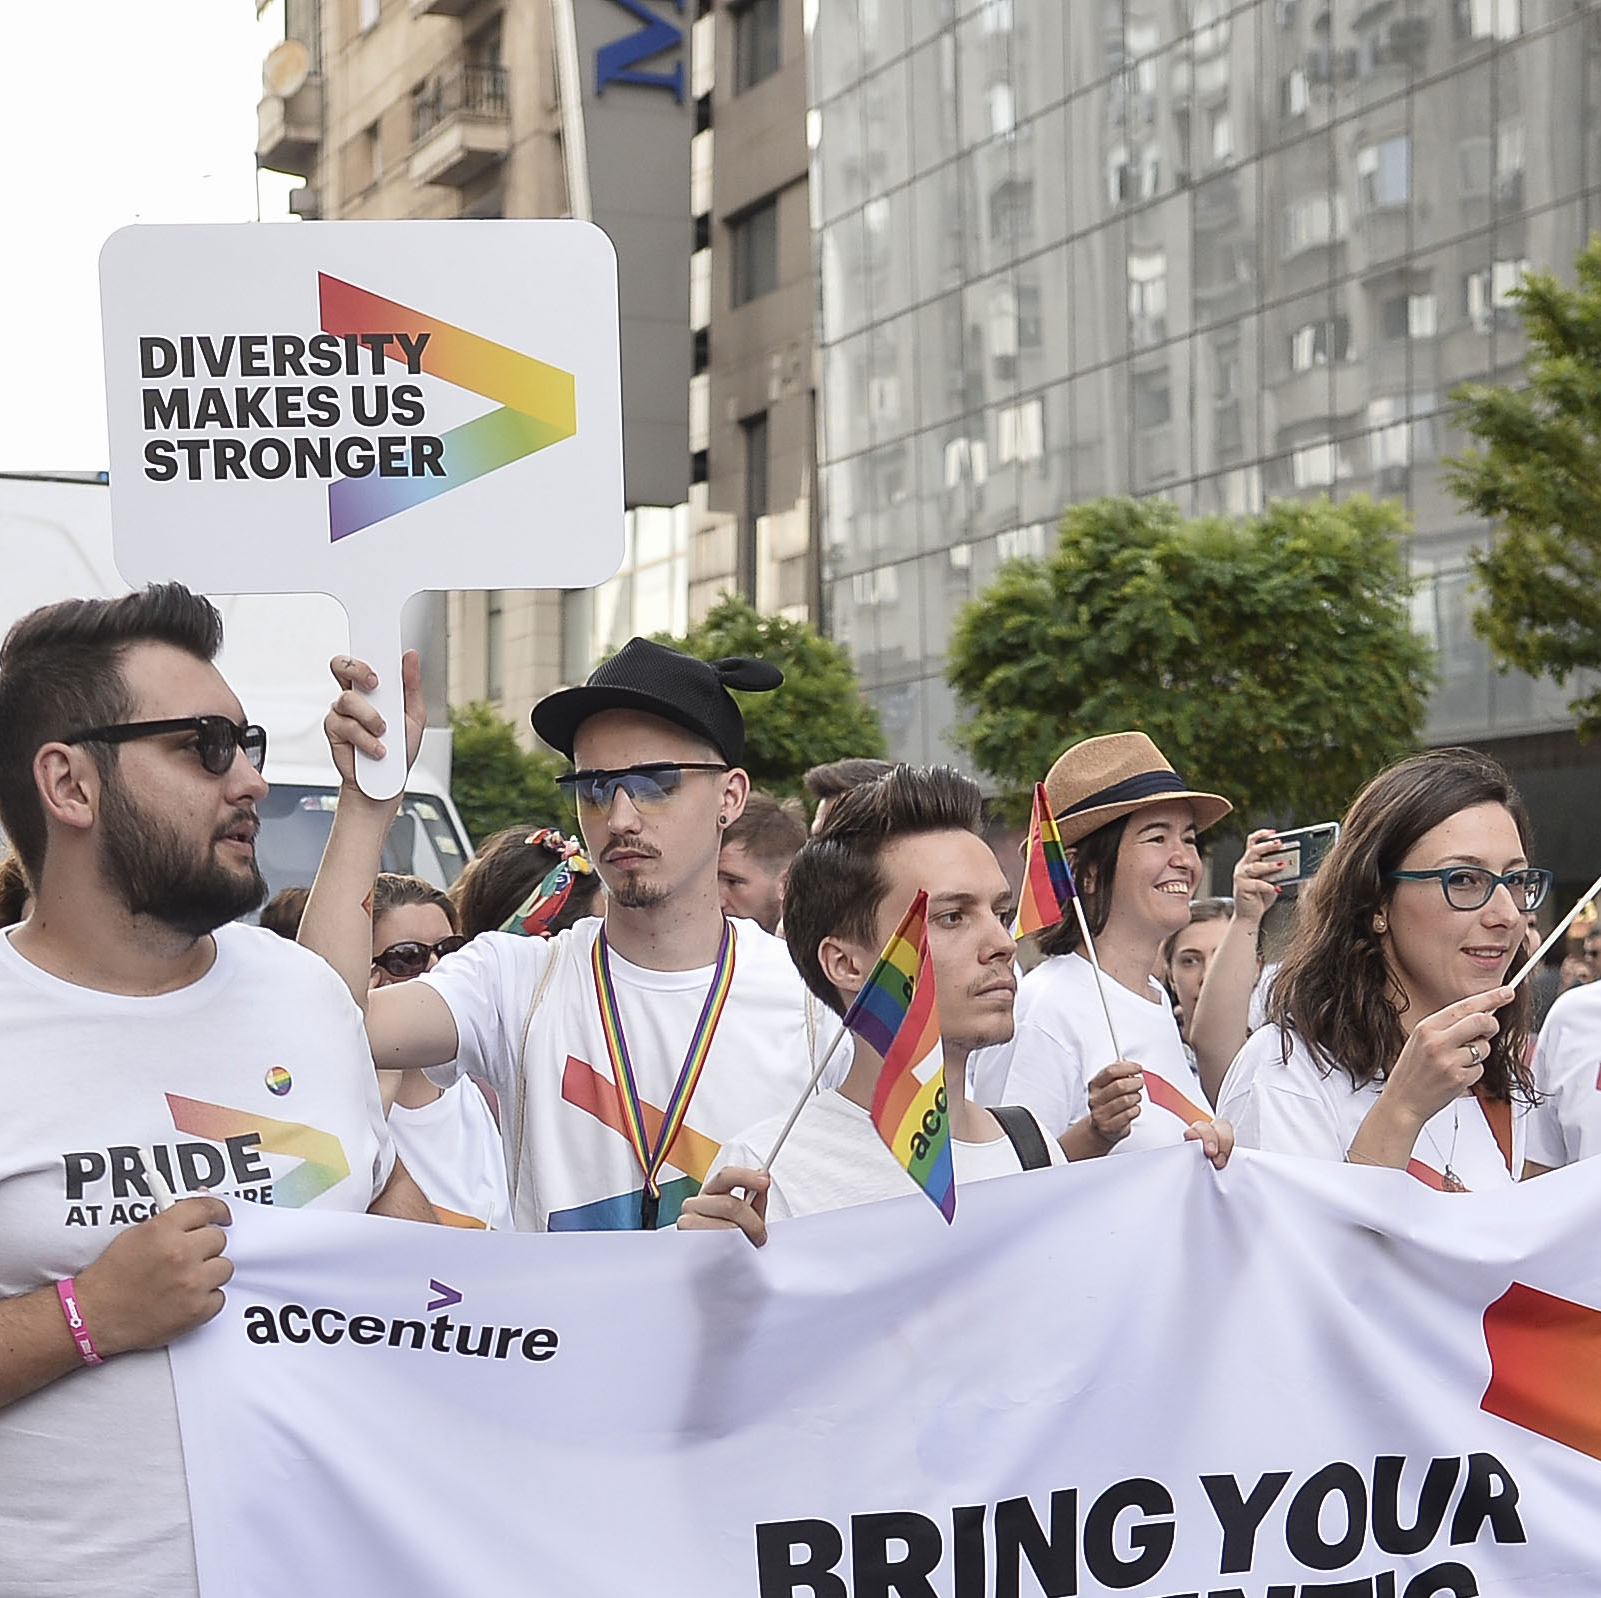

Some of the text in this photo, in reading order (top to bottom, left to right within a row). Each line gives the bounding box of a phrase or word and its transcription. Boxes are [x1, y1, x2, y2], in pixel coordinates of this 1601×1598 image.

[140, 333, 431, 378] DIVERSITY
[142, 384, 425, 430] MAKES US
[144, 435, 447, 481] STRONGER
[63, 1132, 272, 1200] PRIDE
[65, 1206, 102, 1226] AT
[244, 1304, 559, 1361] accenture
[1200, 1453, 1526, 1574] YOUR
